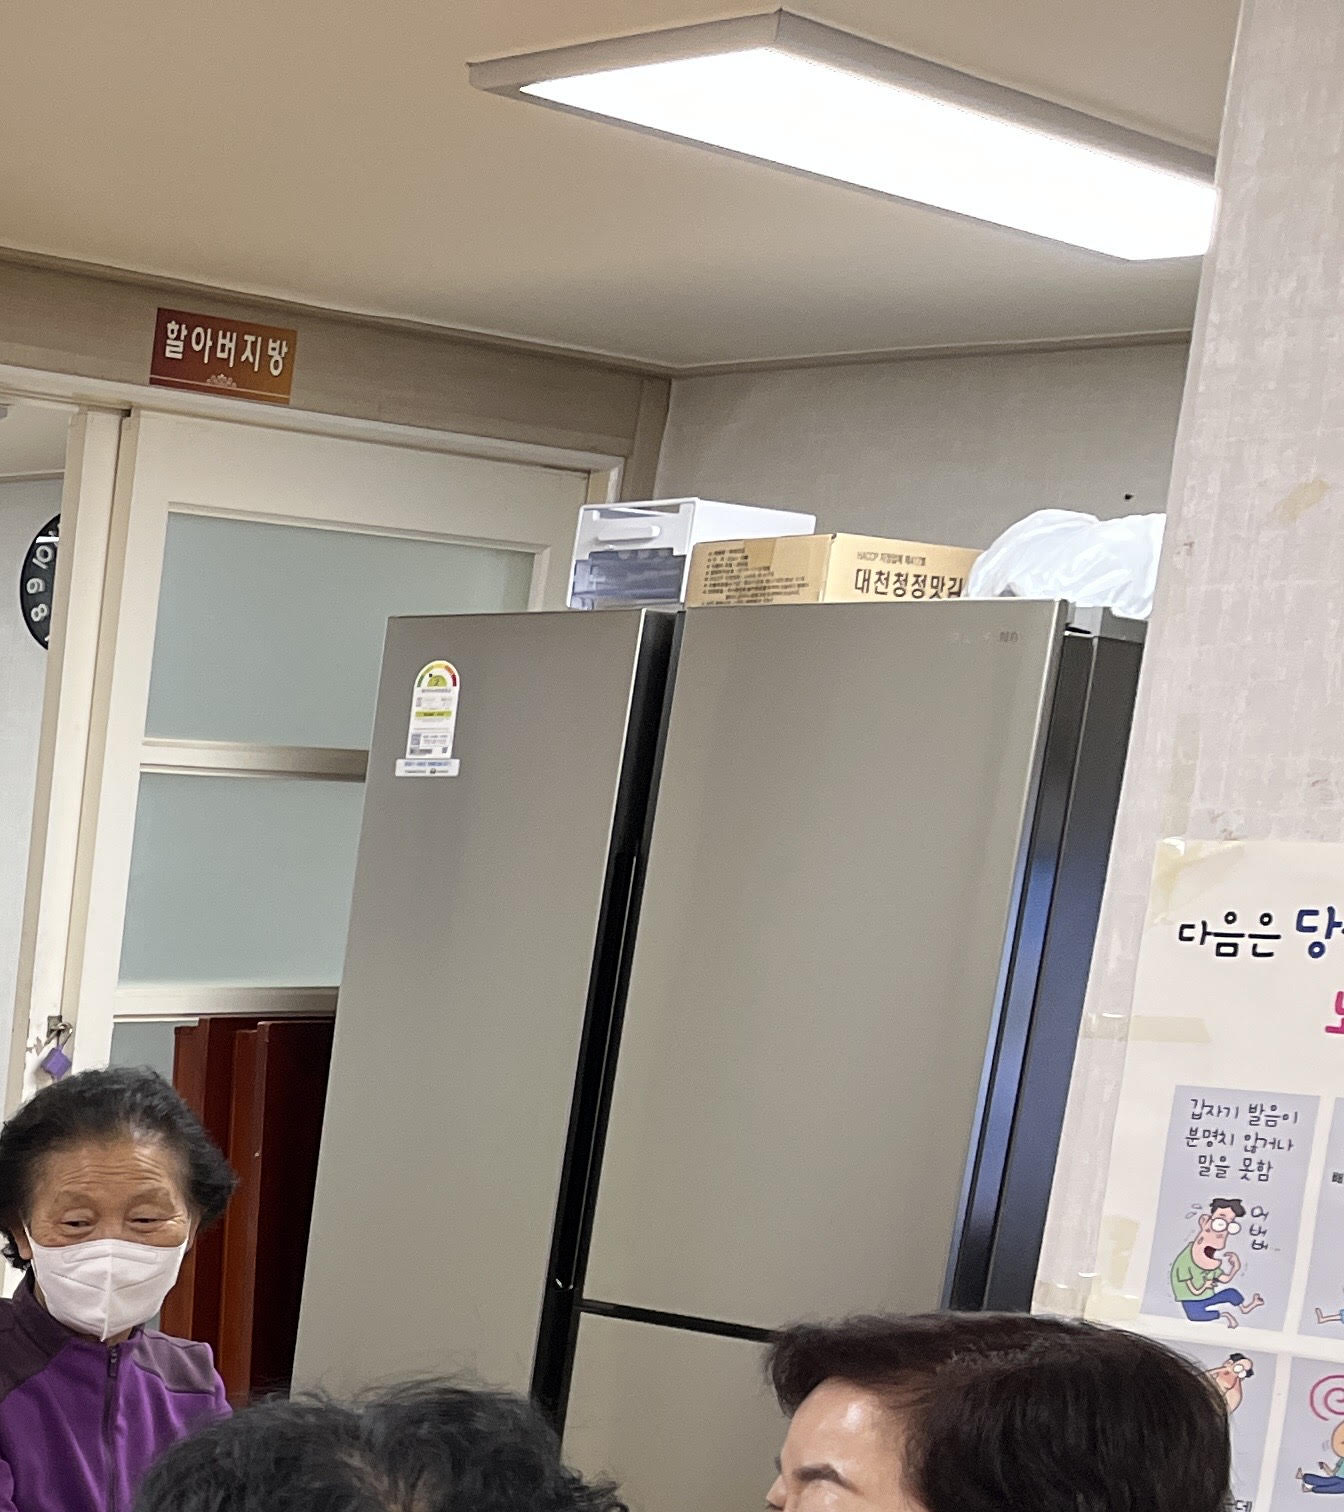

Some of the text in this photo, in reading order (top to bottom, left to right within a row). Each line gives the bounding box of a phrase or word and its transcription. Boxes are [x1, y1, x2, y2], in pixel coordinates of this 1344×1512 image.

[164, 319, 289, 377] 할아버지방
[1178, 905, 1344, 959] 다음은 당
[1190, 1098, 1298, 1128] 갑자기 발음이
[1185, 1126, 1294, 1154] 분명치 않거나
[1198, 1154, 1274, 1183] 말을 못함
